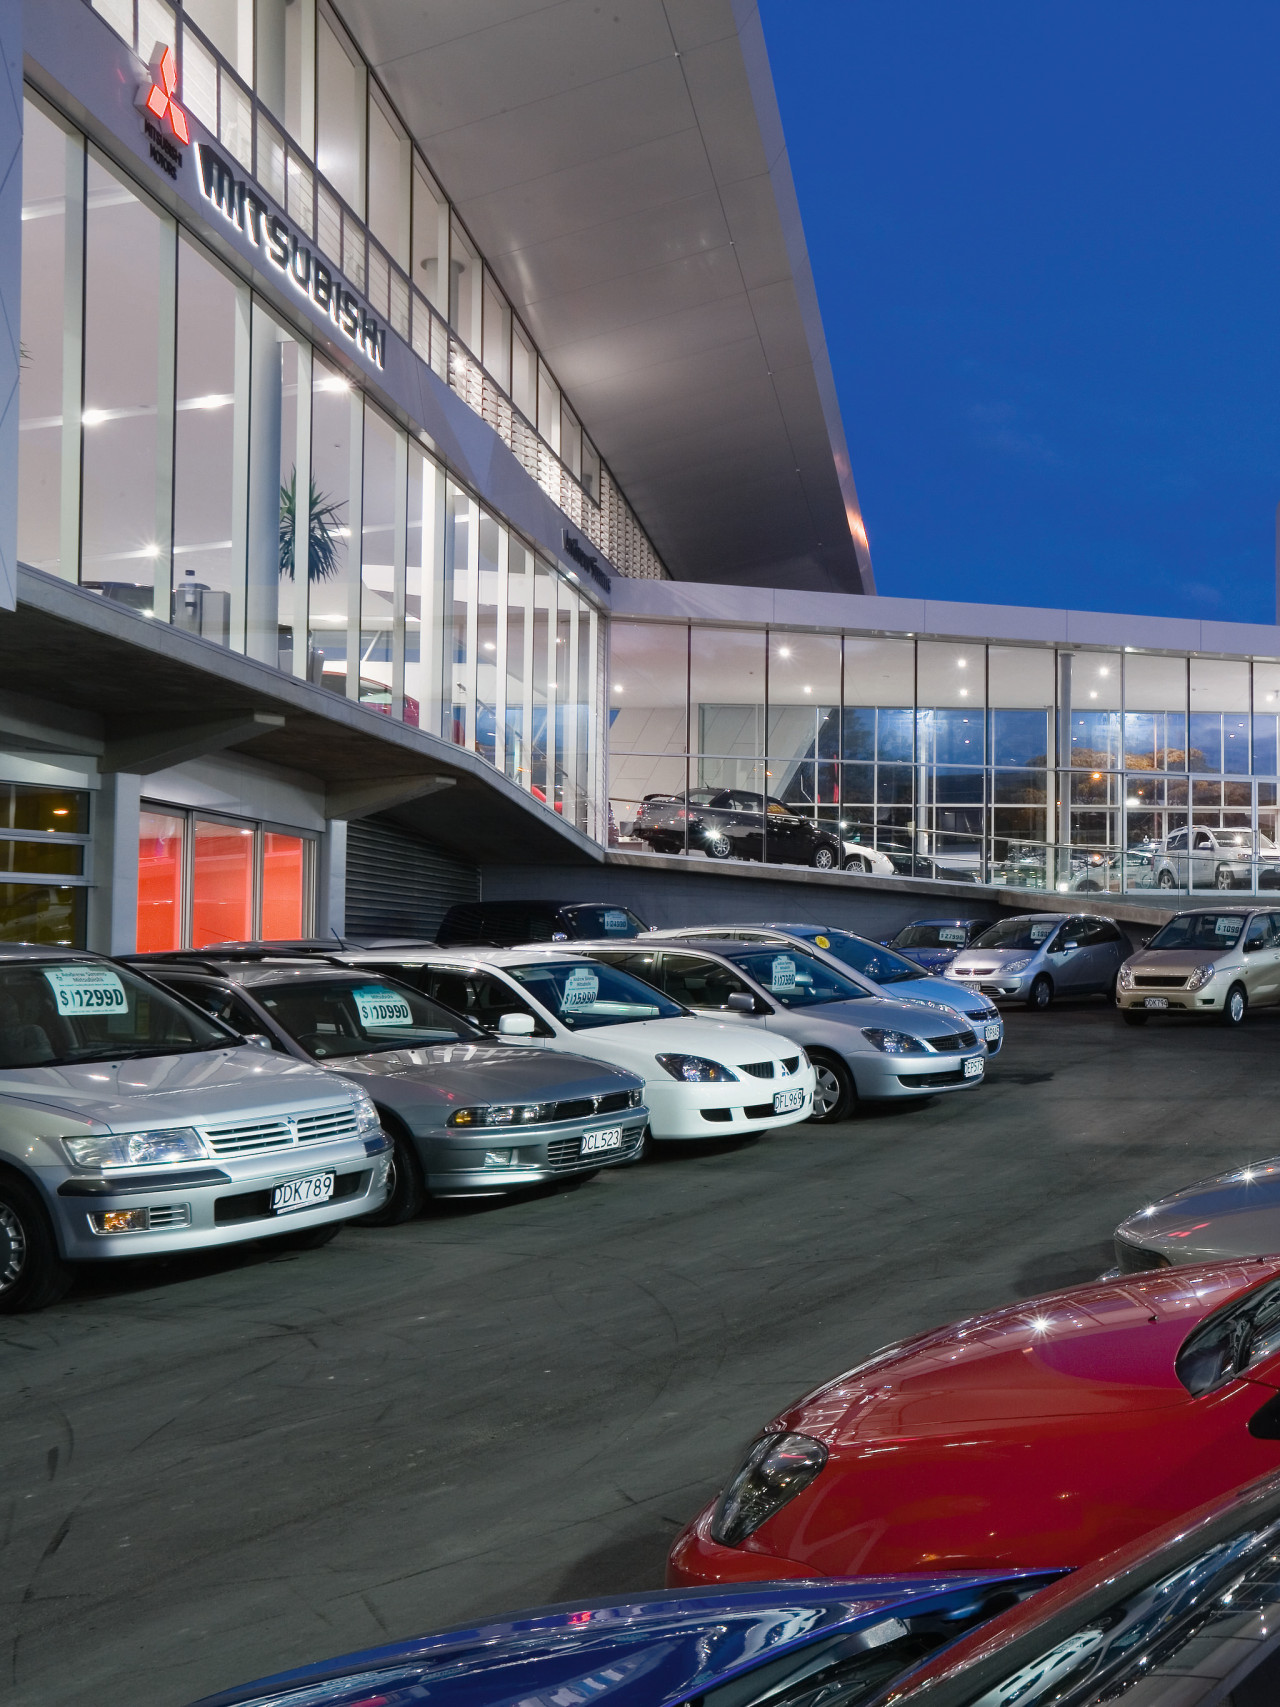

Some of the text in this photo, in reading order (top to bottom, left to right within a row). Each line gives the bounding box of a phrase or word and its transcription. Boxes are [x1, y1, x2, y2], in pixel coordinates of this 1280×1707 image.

[194, 141, 386, 370] MITSUBISHI
[775, 1091, 802, 1109] DFL969
[273, 1176, 333, 1206] DDK789
